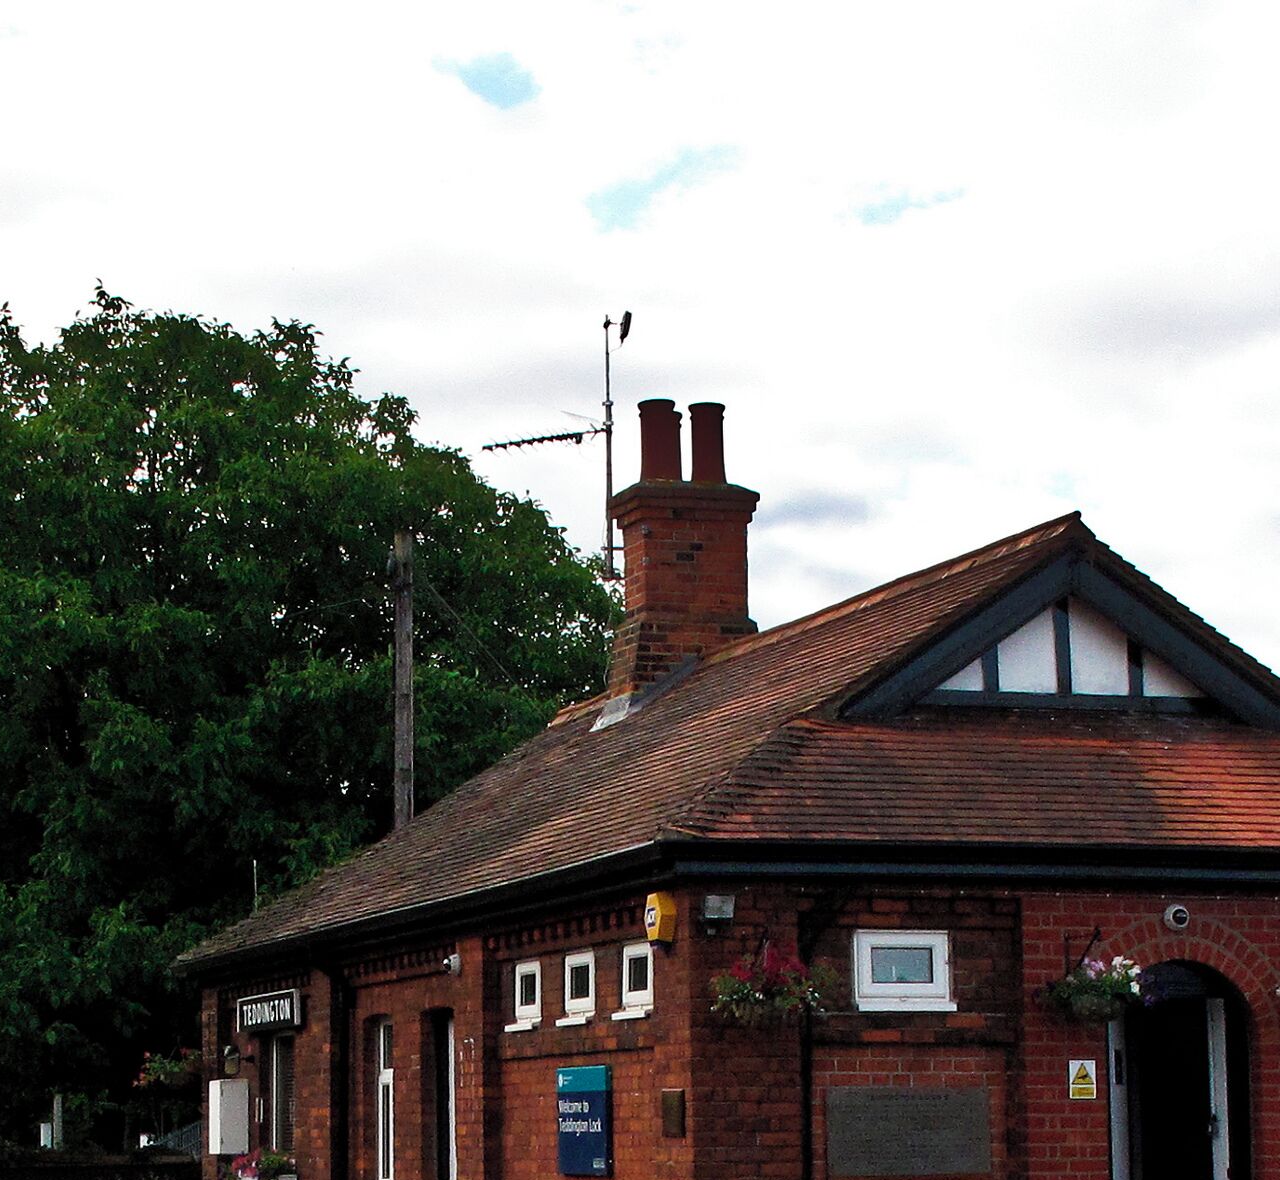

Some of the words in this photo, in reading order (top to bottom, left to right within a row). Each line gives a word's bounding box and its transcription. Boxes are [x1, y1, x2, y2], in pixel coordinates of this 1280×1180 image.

[243, 998, 290, 1026] TEDDINGTON
[558, 1099, 582, 1113] Welcome
[558, 1117, 588, 1137] Teddington
[589, 1117, 602, 1132] Lock
